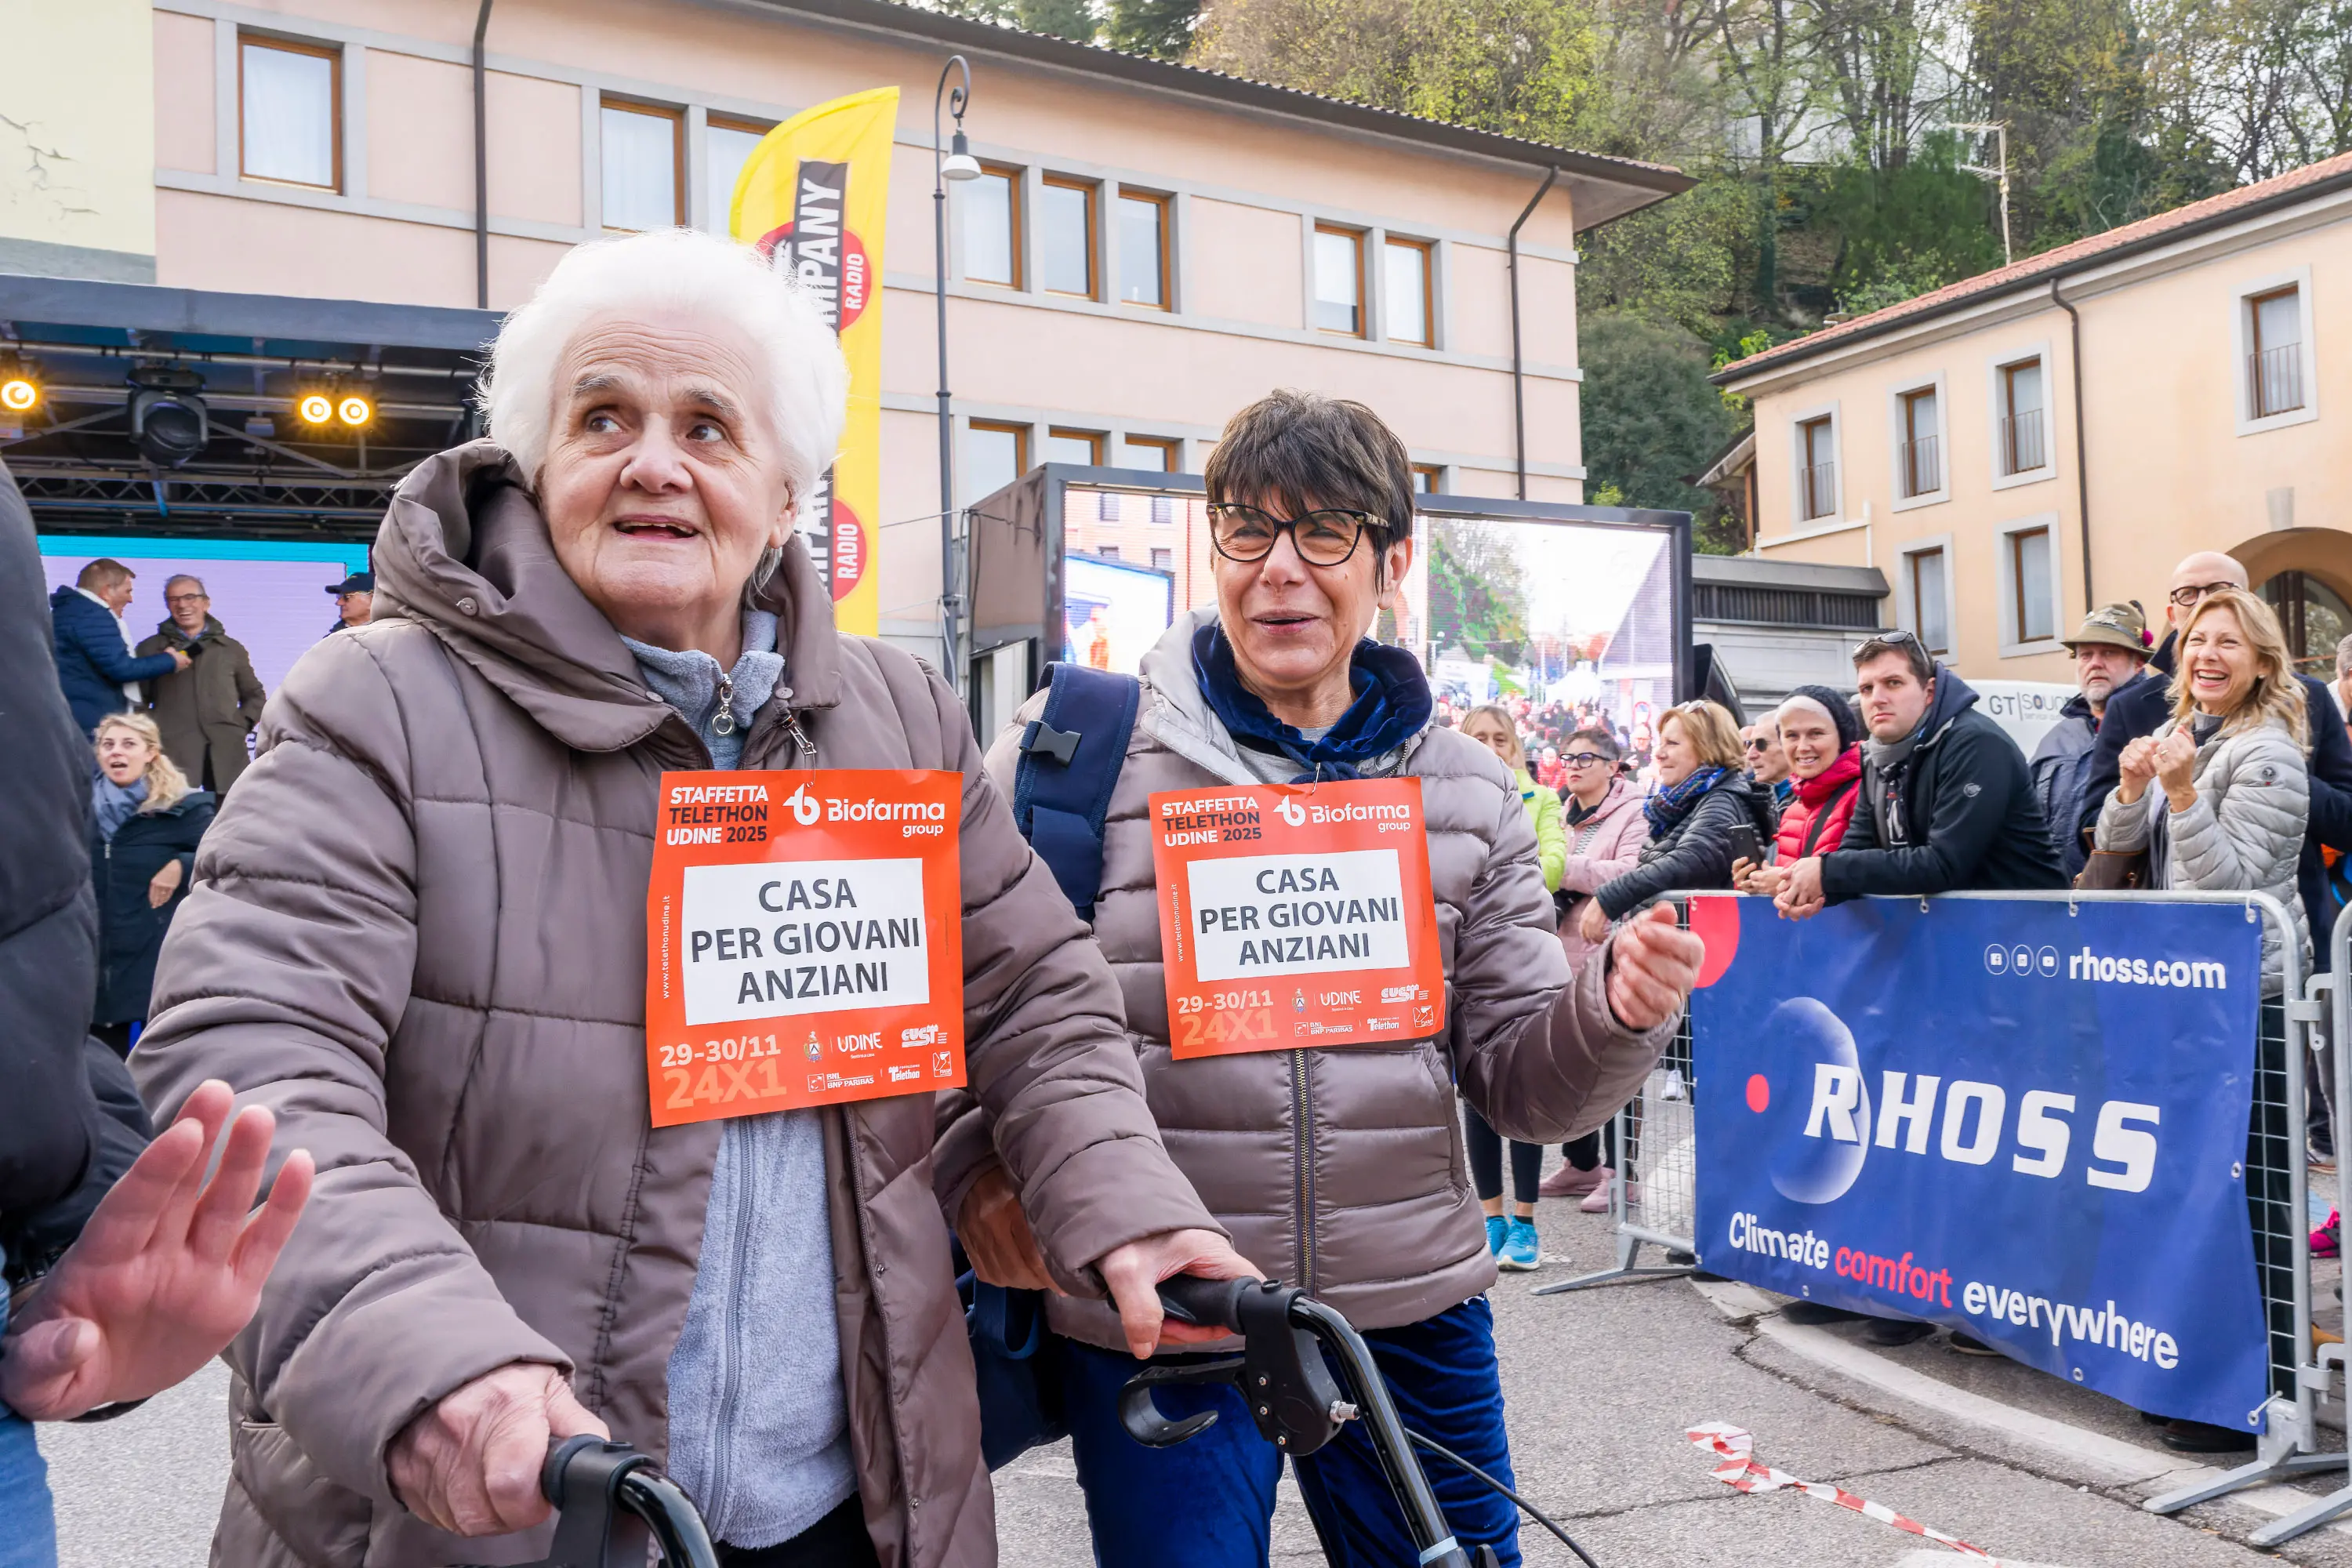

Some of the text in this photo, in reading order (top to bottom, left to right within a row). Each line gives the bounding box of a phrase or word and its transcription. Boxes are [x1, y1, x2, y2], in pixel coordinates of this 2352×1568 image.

[844, 253, 865, 310] RADIO
[837, 523, 858, 579] RADIO
[1989, 695, 2015, 715] GT
[670, 785, 769, 804] STAFFETTA
[1161, 797, 1259, 816] STAFFETTA
[669, 805, 768, 825] TELETHON
[826, 798, 946, 822] Biofarma
[1162, 811, 1261, 831] TELETHON
[1309, 803, 1410, 823] Biofarma
[666, 826, 767, 846] UDINE 2025
[902, 824, 944, 838] group
[1164, 827, 1262, 847] UDINE 2025
[1377, 821, 1411, 833] group
[1256, 868, 1339, 894] CASA
[758, 878, 857, 913] CASA
[1171, 884, 1184, 963] www.telethonudine.it
[1200, 906, 1260, 934] PER
[1268, 897, 1399, 928] GIOVANI
[661, 895, 670, 1000] www.telethonudine.it
[691, 927, 763, 963] PER
[773, 917, 920, 955] GIOVANI
[1239, 933, 1370, 966] ANZIANI
[2069, 946, 2227, 989] rhoss.com
[738, 961, 888, 1004] ANZIANI
[1177, 989, 1274, 1014] 29-30/11
[1320, 990, 1363, 1006] UDINE
[1179, 1008, 1279, 1047] 24X1
[1367, 1018, 1399, 1032] Telethon
[659, 1034, 781, 1068] 29-30/11
[837, 1032, 883, 1053] UDINE
[662, 1058, 787, 1109] 24X1
[827, 1077, 874, 1089] BNP PARIBAS
[888, 1065, 920, 1082] Telethon
[1803, 1063, 2160, 1193] RHOSS
[1729, 1211, 2180, 1370] Climate comfort everywhere
